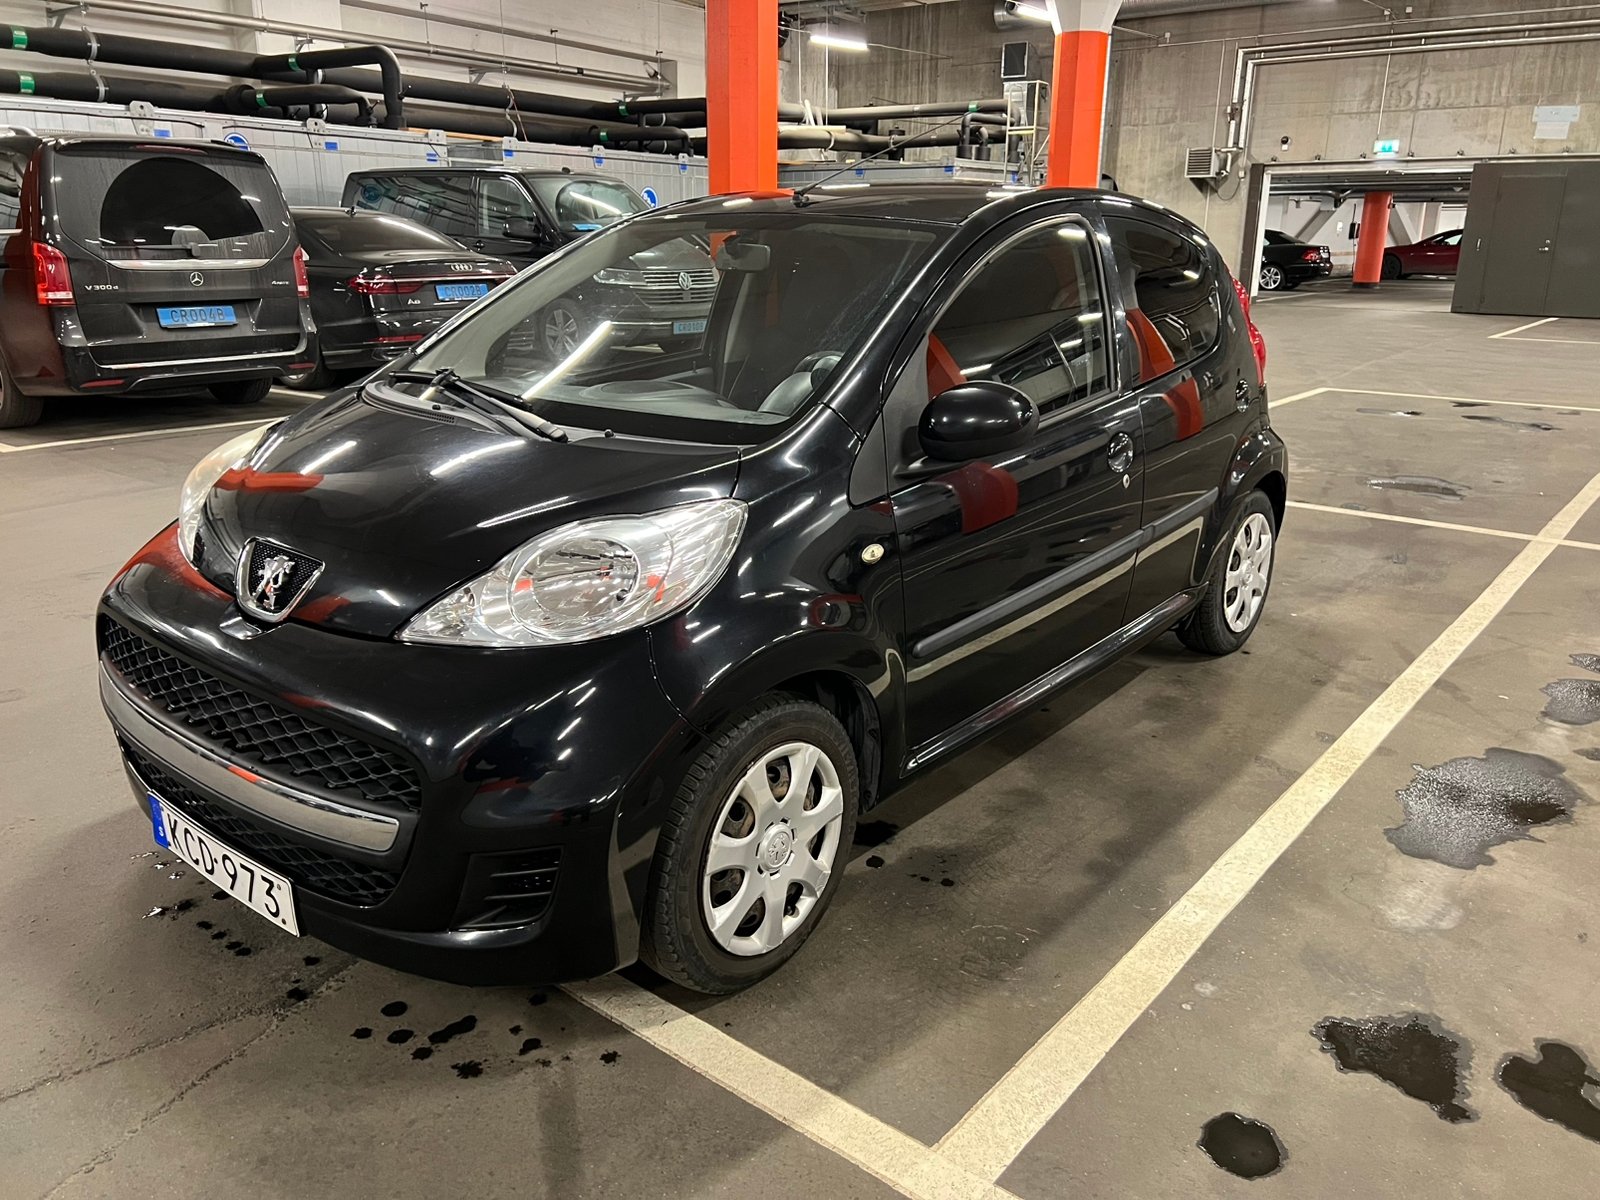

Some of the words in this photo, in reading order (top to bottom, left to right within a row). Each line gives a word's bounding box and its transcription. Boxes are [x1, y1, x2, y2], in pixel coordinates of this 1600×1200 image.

[444, 285, 482, 297] CR002B
[170, 308, 226, 323] CR004B
[158, 826, 165, 837] S
[221, 854, 280, 918] 973
